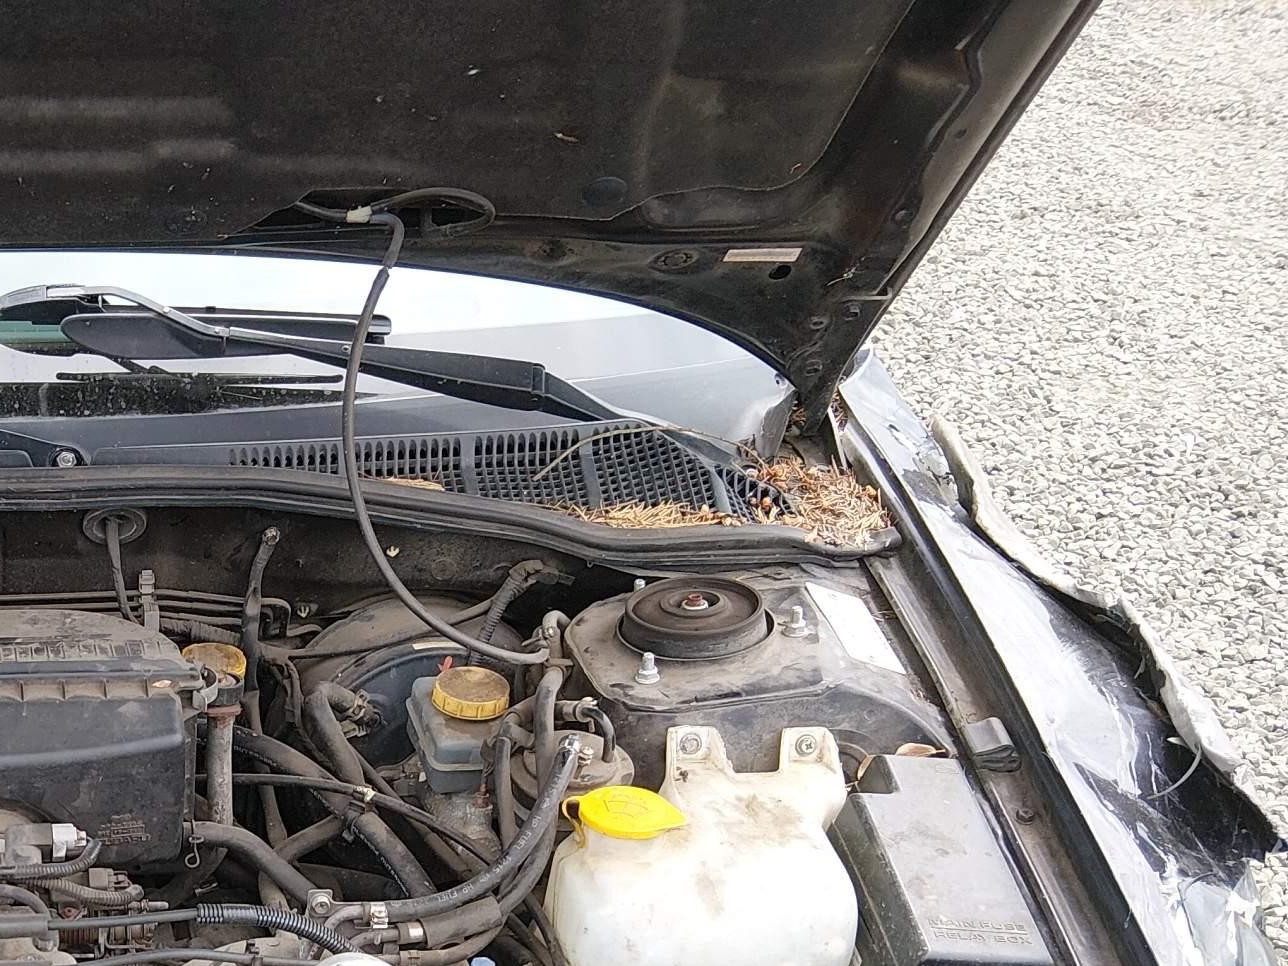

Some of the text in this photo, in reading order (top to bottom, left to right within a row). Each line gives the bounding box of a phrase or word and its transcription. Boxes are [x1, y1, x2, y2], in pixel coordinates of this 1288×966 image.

[532, 815, 542, 827] HP
[513, 830, 532, 850] FUEL
[463, 883, 474, 894] HP
[438, 891, 458, 903] FUEL
[928, 919, 1027, 931] MAIN FUSE
[934, 931, 1032, 945] RELAY BOX
